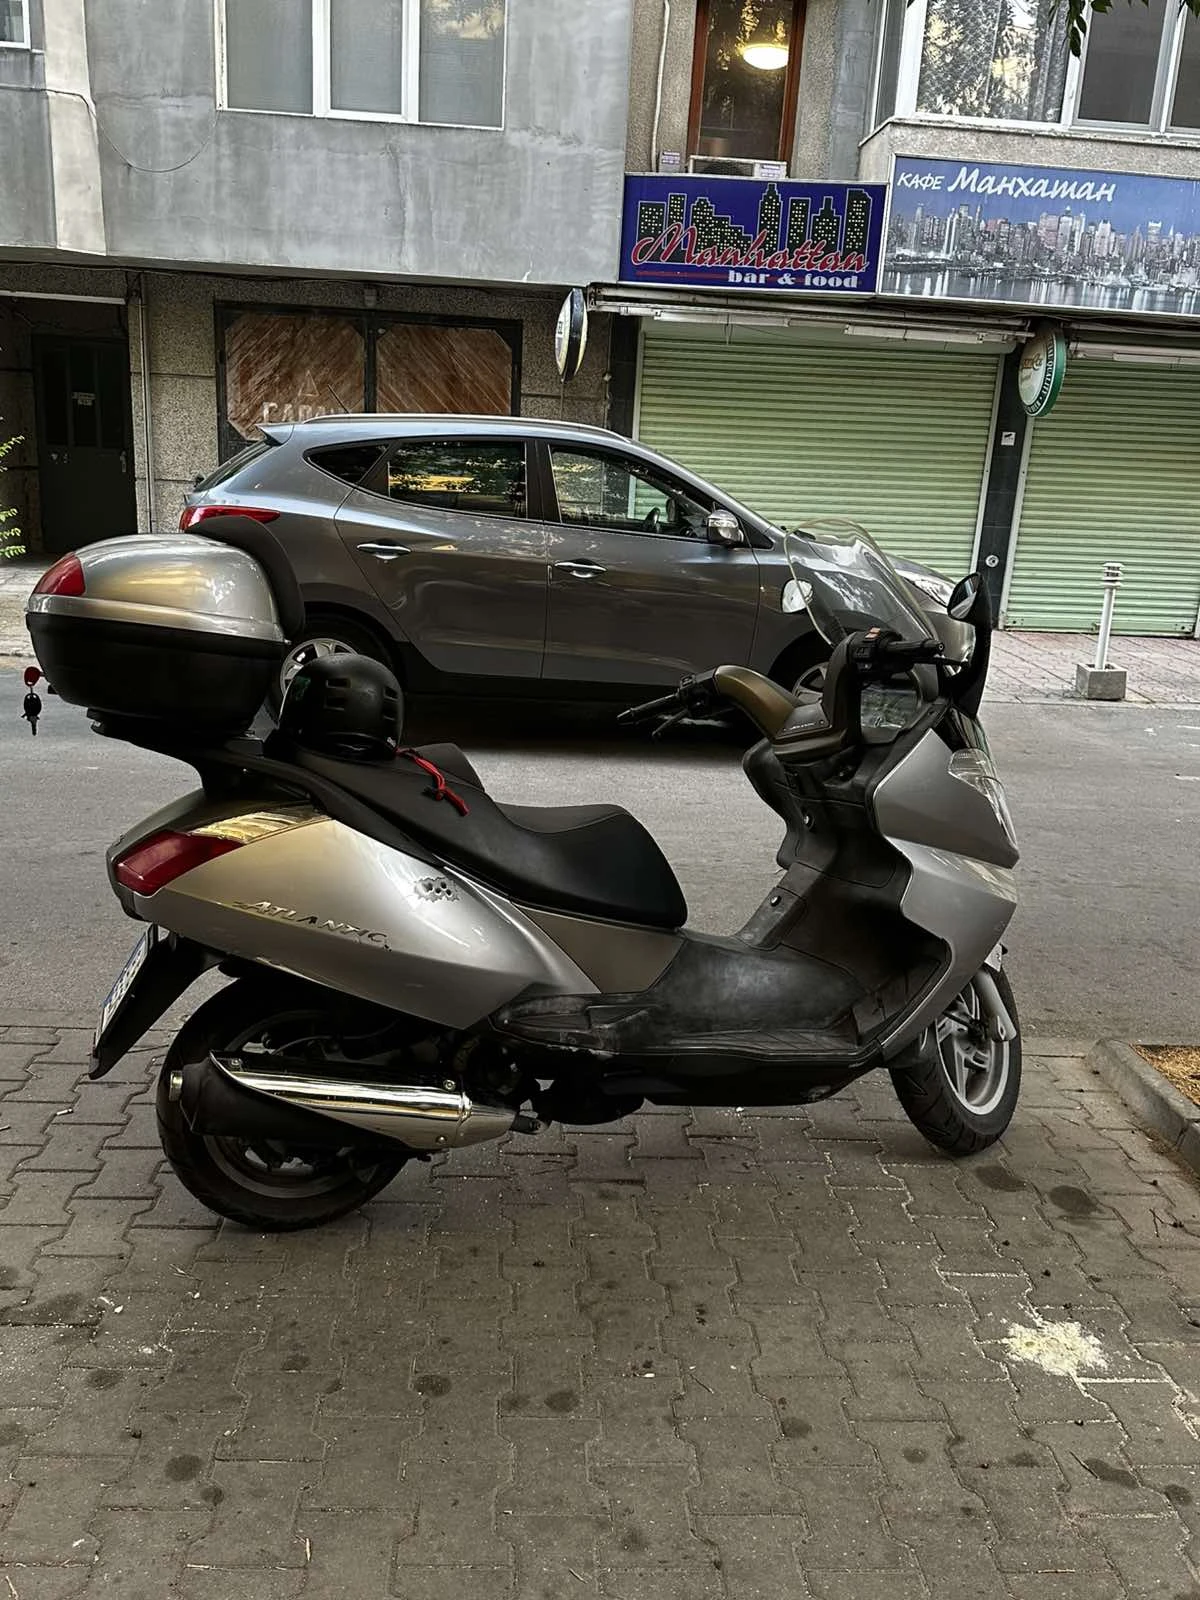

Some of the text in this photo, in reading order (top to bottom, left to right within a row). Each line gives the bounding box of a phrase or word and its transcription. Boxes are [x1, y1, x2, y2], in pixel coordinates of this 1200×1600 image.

[897, 166, 1117, 202] КАФЕ Манхатан
[631, 222, 870, 274] Manhattan
[727, 269, 859, 288] bar & food
[241, 900, 389, 944] ATLANTIC
